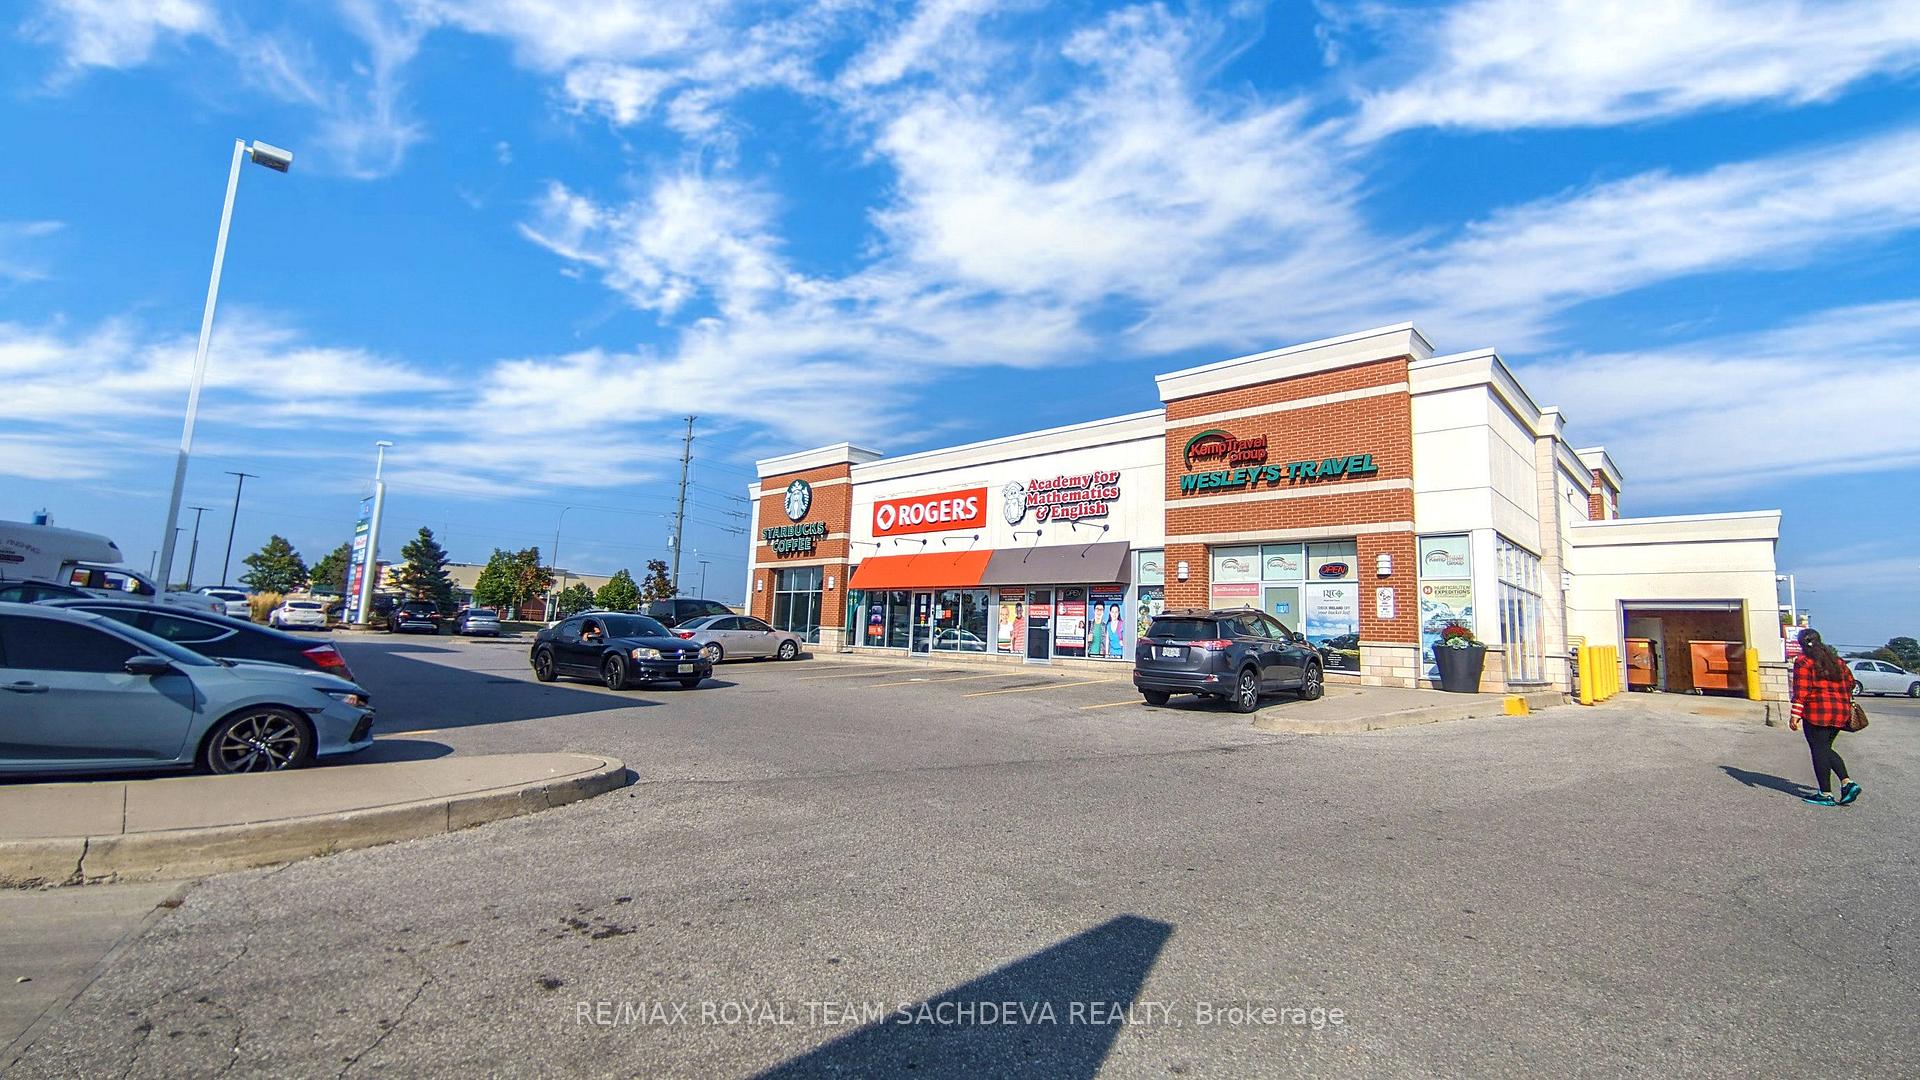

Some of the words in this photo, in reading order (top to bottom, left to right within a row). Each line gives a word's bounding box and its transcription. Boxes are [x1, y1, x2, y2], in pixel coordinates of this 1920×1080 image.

[1190, 441, 1228, 457] Kemp
[1226, 434, 1267, 451] Travel
[1229, 448, 1266, 463] Group
[1027, 474, 1091, 492] Academy
[1093, 470, 1119, 484] for
[1180, 465, 1281, 491] WESLEY'S
[1288, 454, 1378, 479] TRAVEL
[1026, 486, 1119, 505] Mathematics
[898, 496, 978, 526] ROGERS
[1035, 506, 1048, 520] &
[1051, 501, 1106, 519] English
[761, 522, 826, 541] STARBUCKS
[772, 537, 812, 553] COFFEE
[1321, 565, 1346, 575] OPEN
